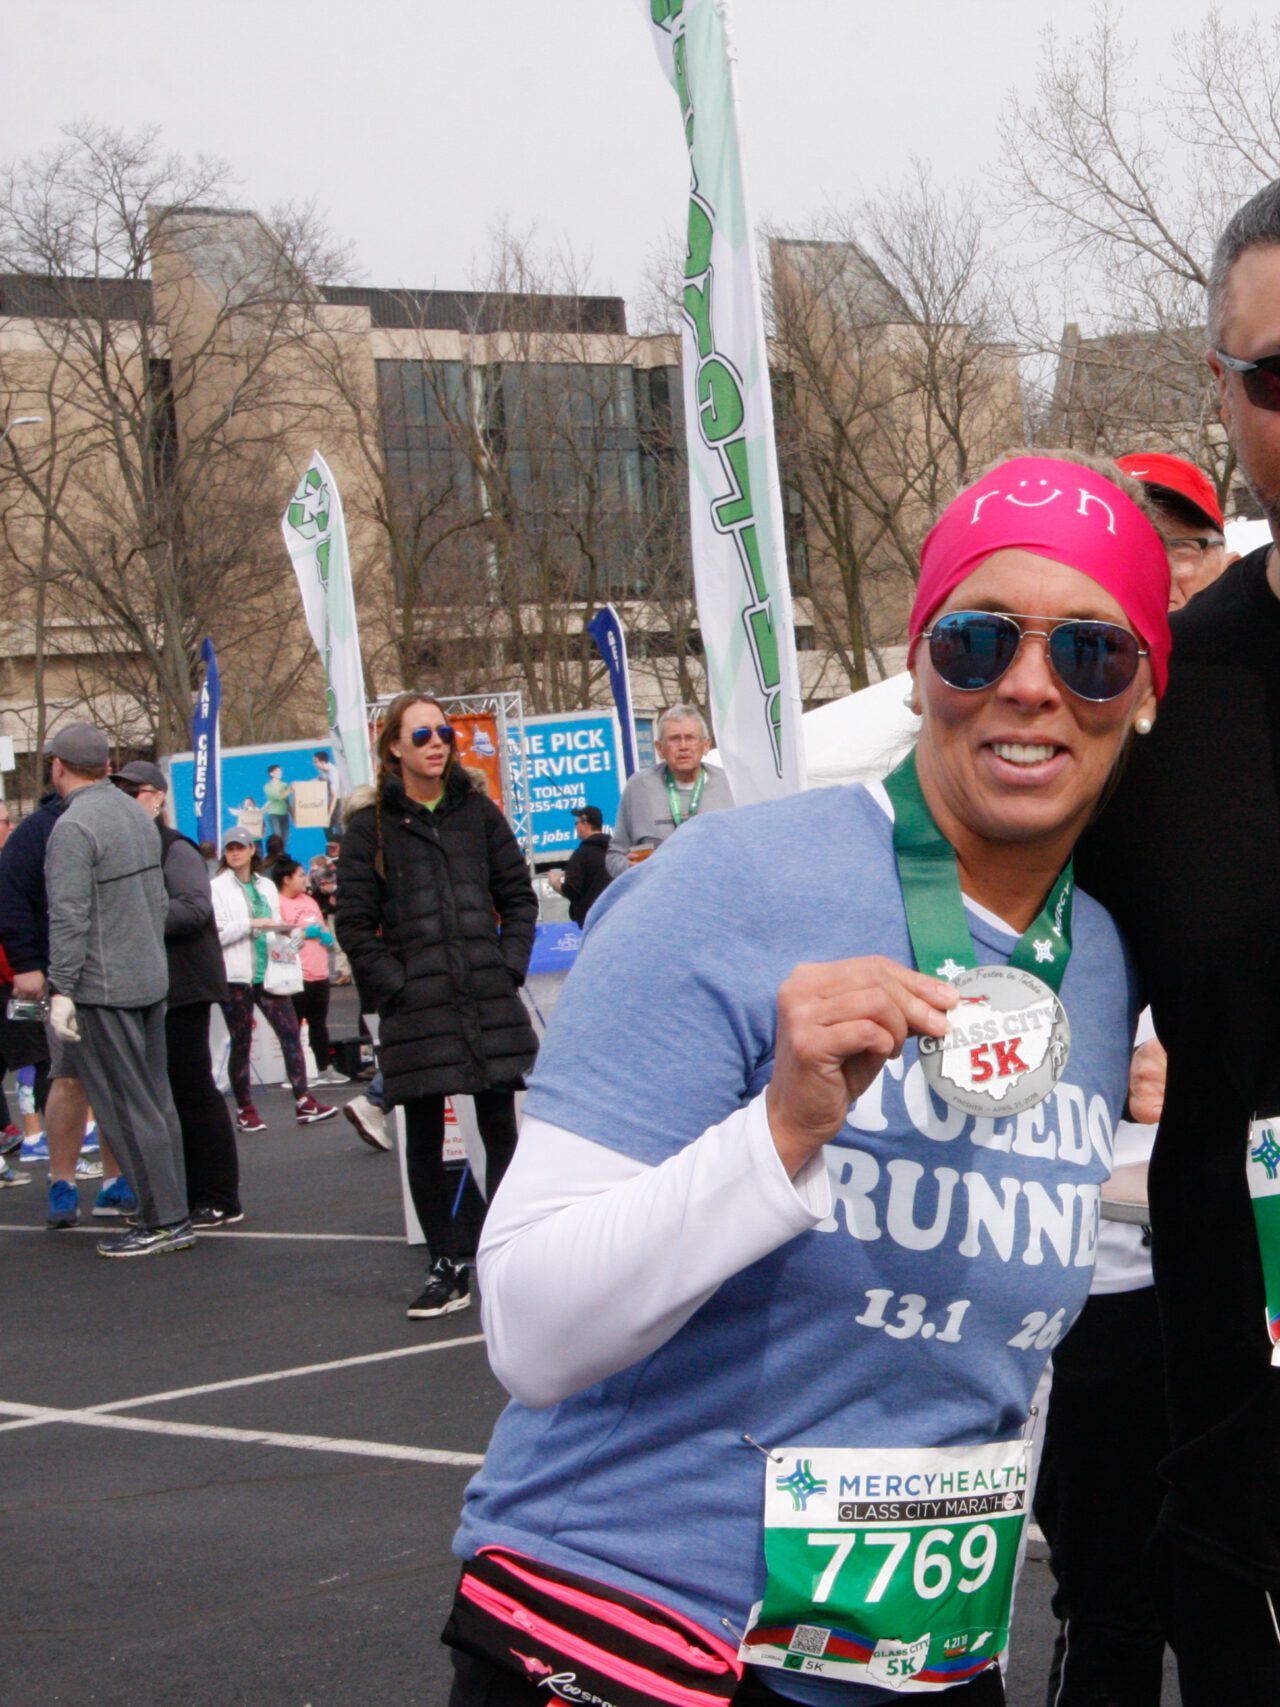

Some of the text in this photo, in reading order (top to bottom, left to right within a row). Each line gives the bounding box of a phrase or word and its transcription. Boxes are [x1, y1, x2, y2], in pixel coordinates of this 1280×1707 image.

[551, 728, 605, 753] PICK
[194, 734, 208, 818] CHECK
[533, 782, 585, 799] TODAY!
[541, 829, 571, 846] jobs
[976, 968, 1004, 980] Faster
[1019, 973, 1042, 994] Toledo
[918, 1003, 1060, 1055] GLASS CITY
[970, 1037, 1030, 1083] 5K
[855, 1288, 971, 1343] 13.1
[839, 1503, 900, 1520] GLASS
[905, 1502, 941, 1518] CITY
[807, 1524, 998, 1603] 7769
[873, 1639, 929, 1658] GLASS CITY
[806, 1661, 824, 1672] 5K
[886, 1657, 916, 1676] 5K
